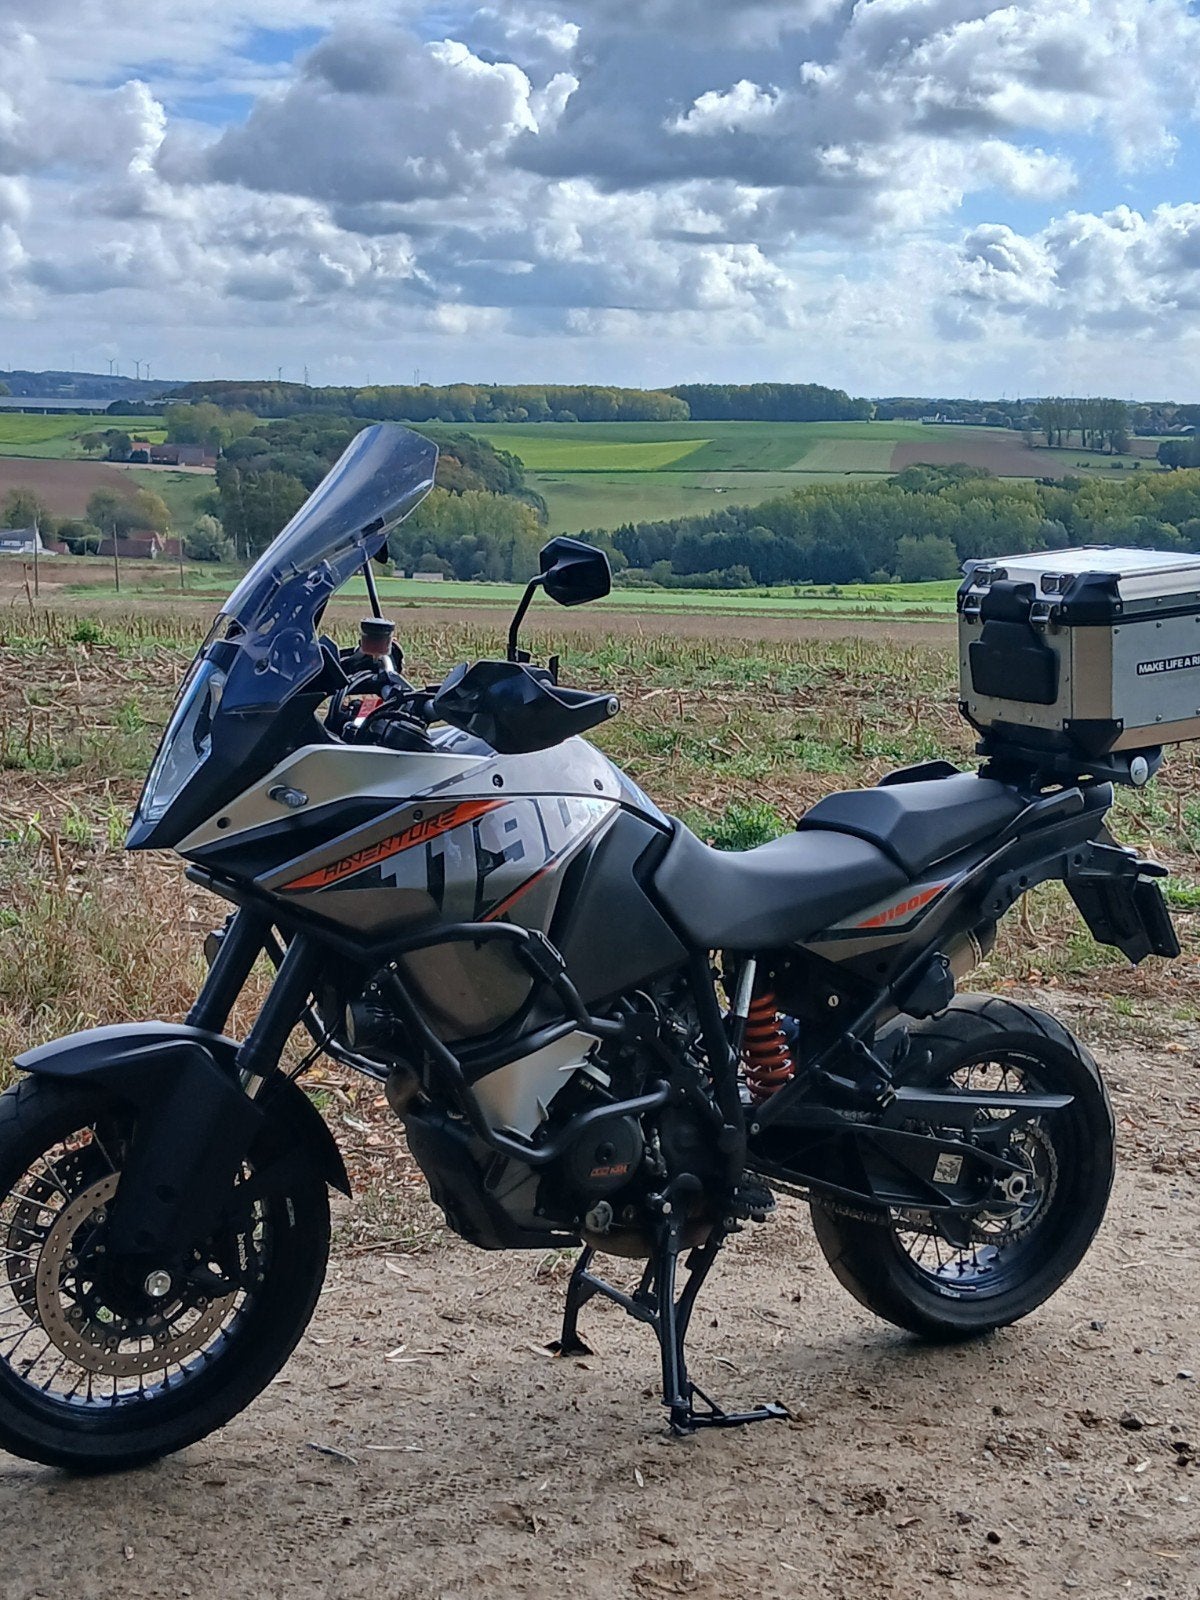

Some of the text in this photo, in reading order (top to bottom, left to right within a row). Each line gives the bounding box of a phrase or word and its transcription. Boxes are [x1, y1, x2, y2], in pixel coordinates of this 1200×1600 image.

[1139, 663, 1164, 674] MAKE
[1165, 660, 1183, 670] LIFE
[1184, 658, 1191, 667] A
[323, 810, 458, 881] ADVENTURE
[237, 1232, 248, 1271] brembo
